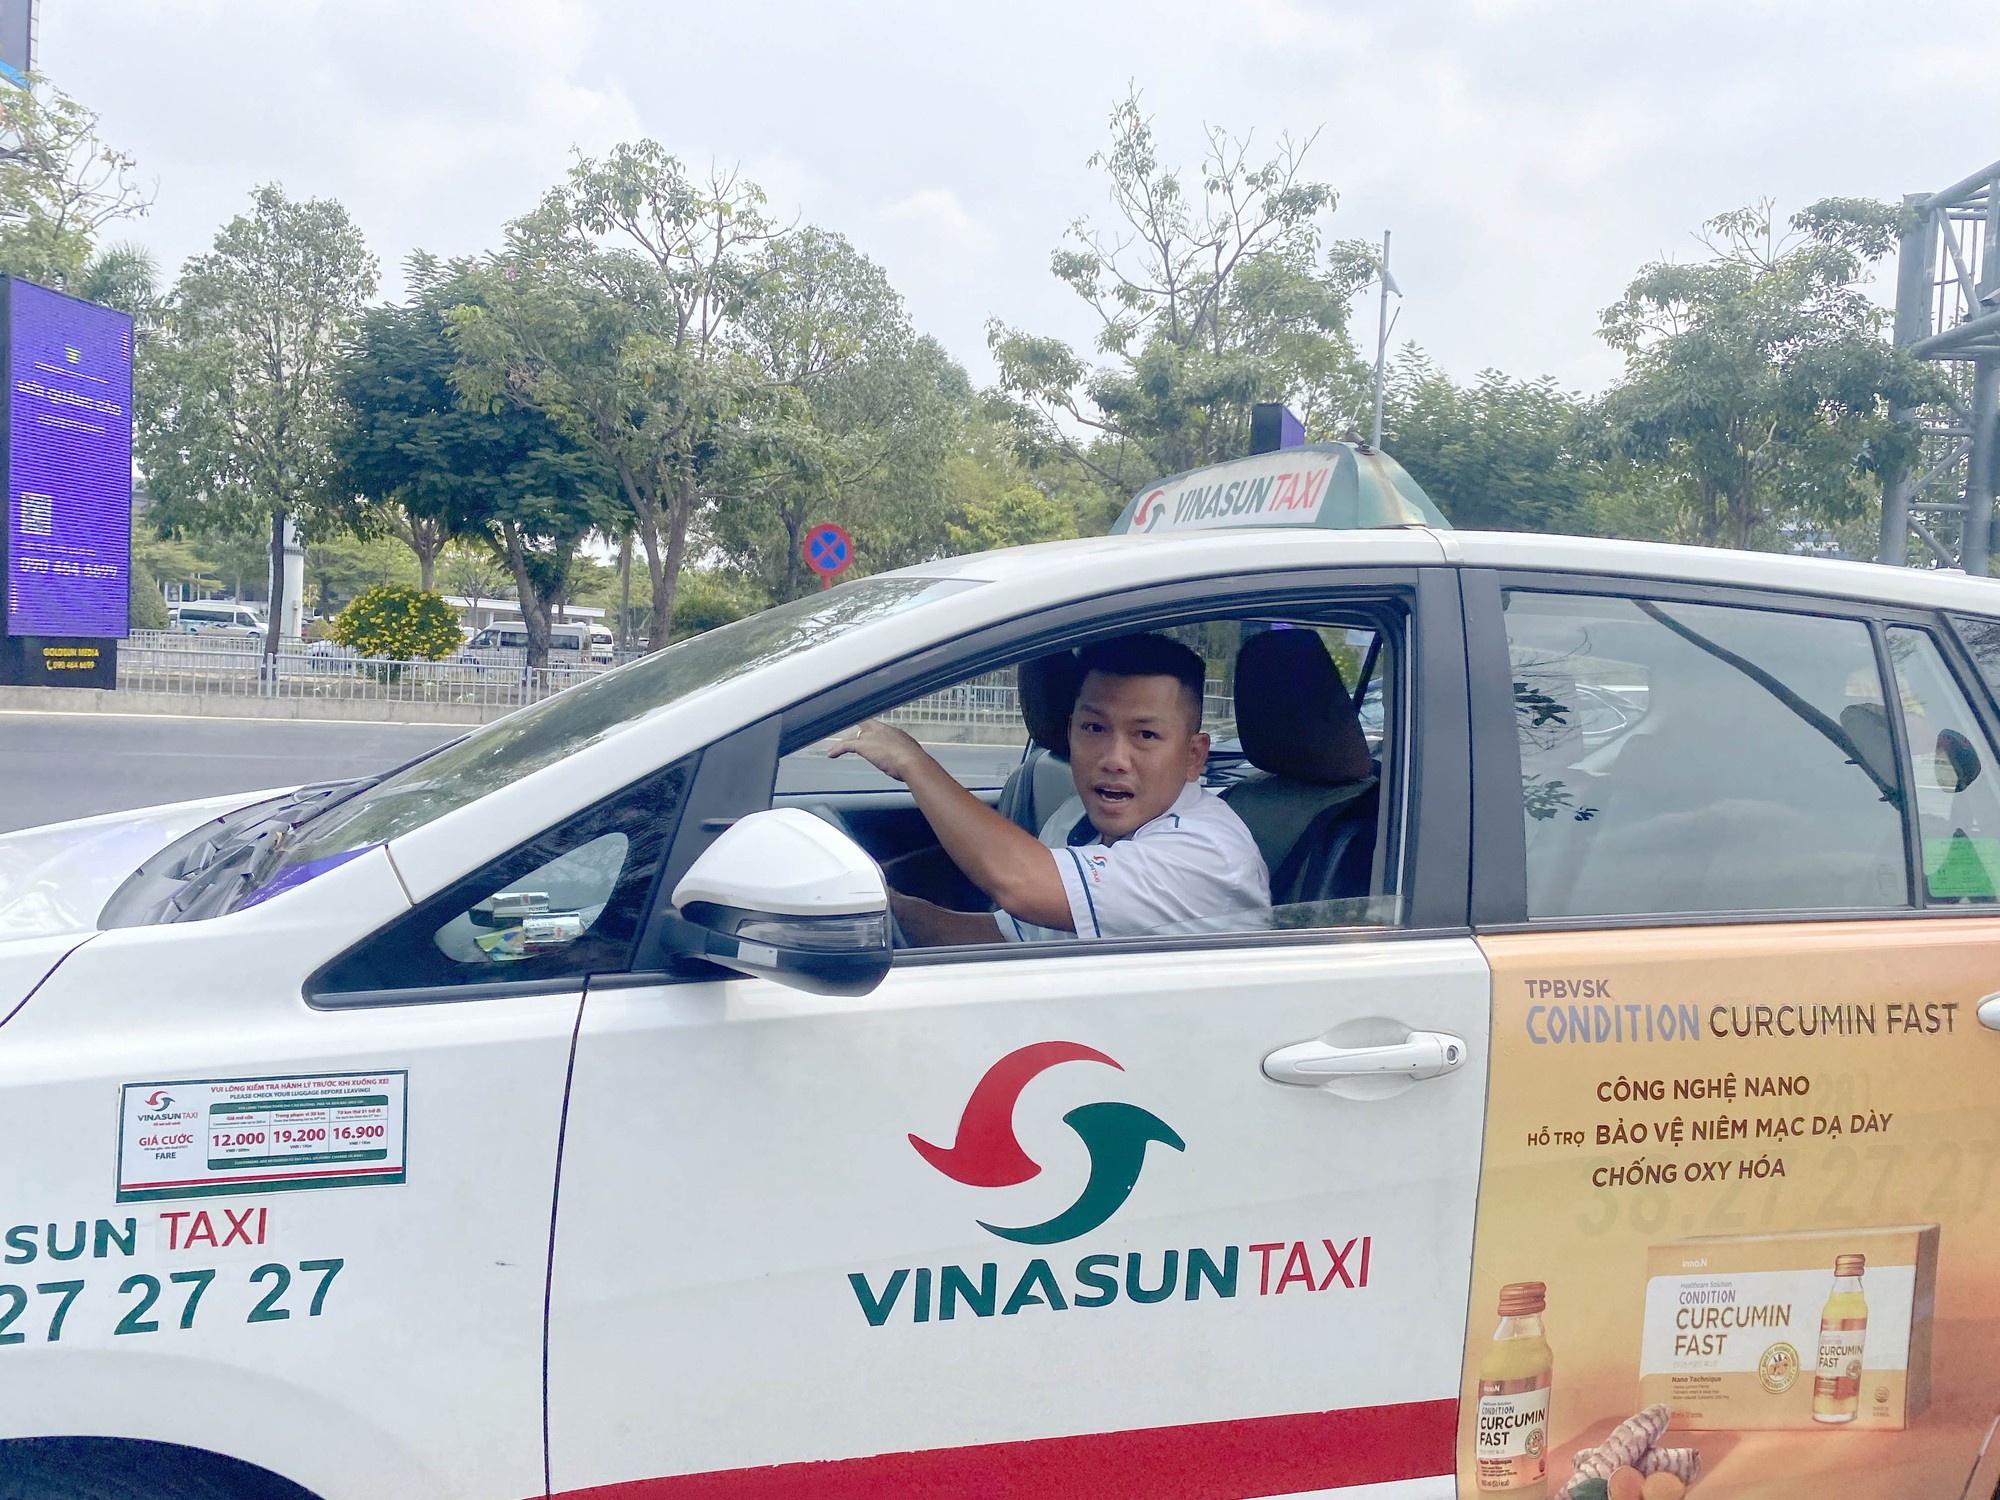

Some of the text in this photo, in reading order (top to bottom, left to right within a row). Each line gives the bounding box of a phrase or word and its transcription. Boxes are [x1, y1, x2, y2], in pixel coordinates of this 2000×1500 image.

[1524, 979, 1612, 999] TPBVSK
[1525, 1002, 1958, 1044] CONDITION CURCUMIN FAST
[1596, 1072, 1810, 1104] CÔNG NGHỆ NANO
[137, 1113, 181, 1122] VINASUN
[1527, 1109, 1893, 1147] HỖ TRỢ BẢO VỆ NIÊM MẠC DẠ DÀY
[139, 1133, 194, 1147] GIÁ CƯỚC
[212, 1125, 384, 1147] 12.000 19.200 16.900
[155, 1152, 177, 1160] FARE
[1592, 1153, 1786, 1187] CHỐNG OXY HÓA
[4, 1207, 268, 1265] SUN TAXI
[1248, 1236, 1372, 1297] TAXI
[0, 1258, 345, 1346] 27 27 27
[1679, 1290, 1737, 1305] CONDITION
[1676, 1304, 1792, 1331] CURCUMIN
[1674, 1334, 1728, 1357] FAST
[1820, 1345, 1864, 1356] CURCUMIN
[1819, 1357, 1839, 1368] FAST
[1481, 1408, 1545, 1430] CURCUMIN
[1482, 1406, 1515, 1415] CONDITION
[1480, 1432, 1510, 1446] FAST
